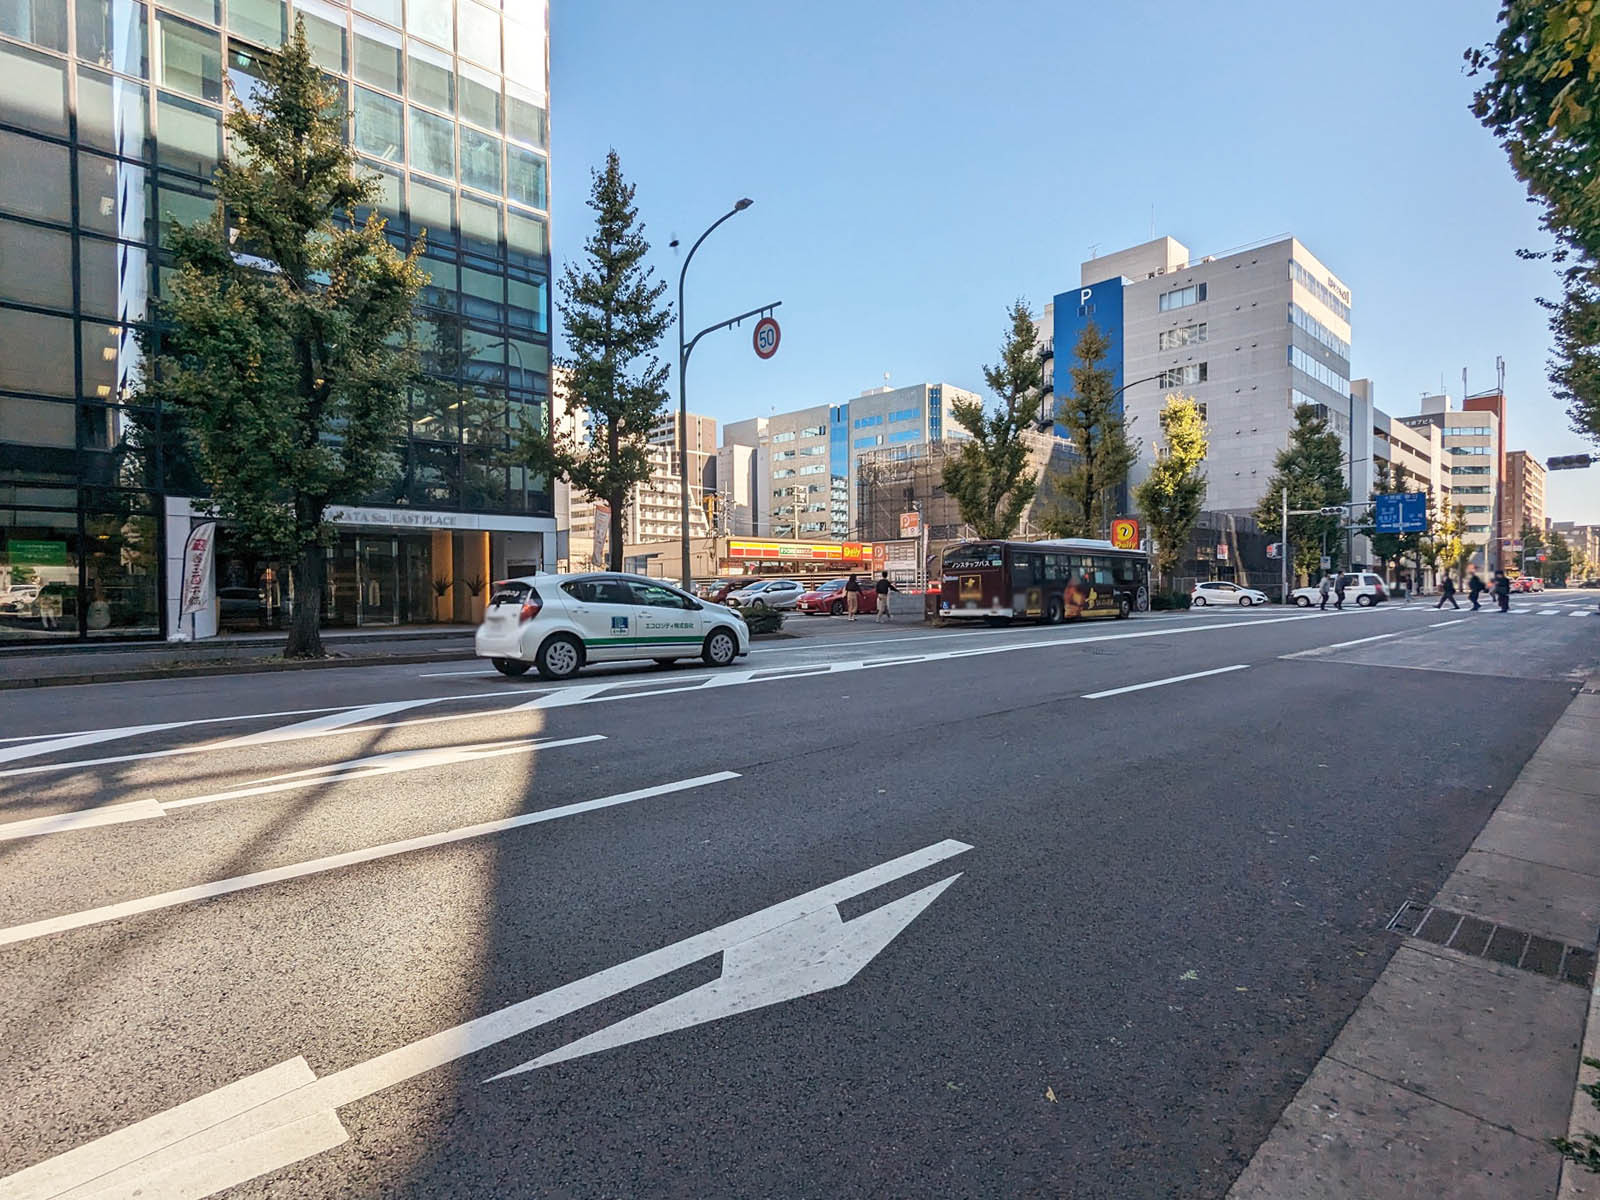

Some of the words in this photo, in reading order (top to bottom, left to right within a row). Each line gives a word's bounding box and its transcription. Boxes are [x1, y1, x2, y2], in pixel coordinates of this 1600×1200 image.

[1081, 288, 1092, 306] P
[759, 328, 775, 348] 50
[392, 513, 419, 525] EAST
[422, 515, 457, 526] PLACE
[952, 560, 990, 568] ノンステップバス
